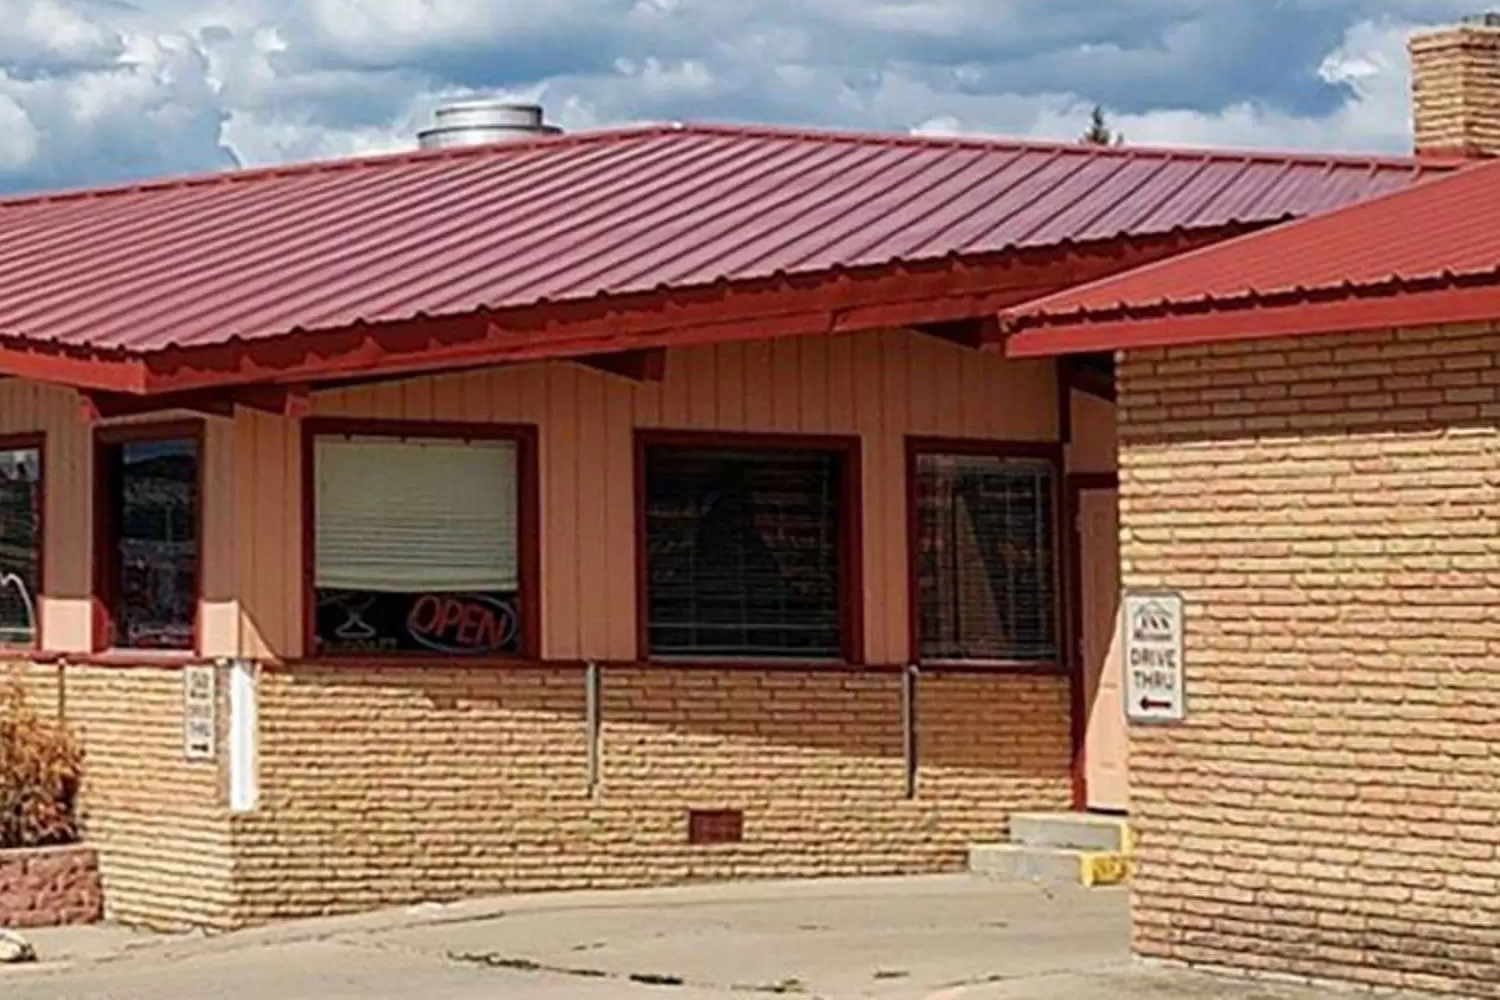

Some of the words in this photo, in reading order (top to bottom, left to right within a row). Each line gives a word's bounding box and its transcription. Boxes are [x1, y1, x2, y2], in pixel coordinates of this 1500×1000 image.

[411, 594, 507, 649] OPEN
[1130, 648, 1177, 668] DRIVE
[1133, 670, 1176, 690] THRU
